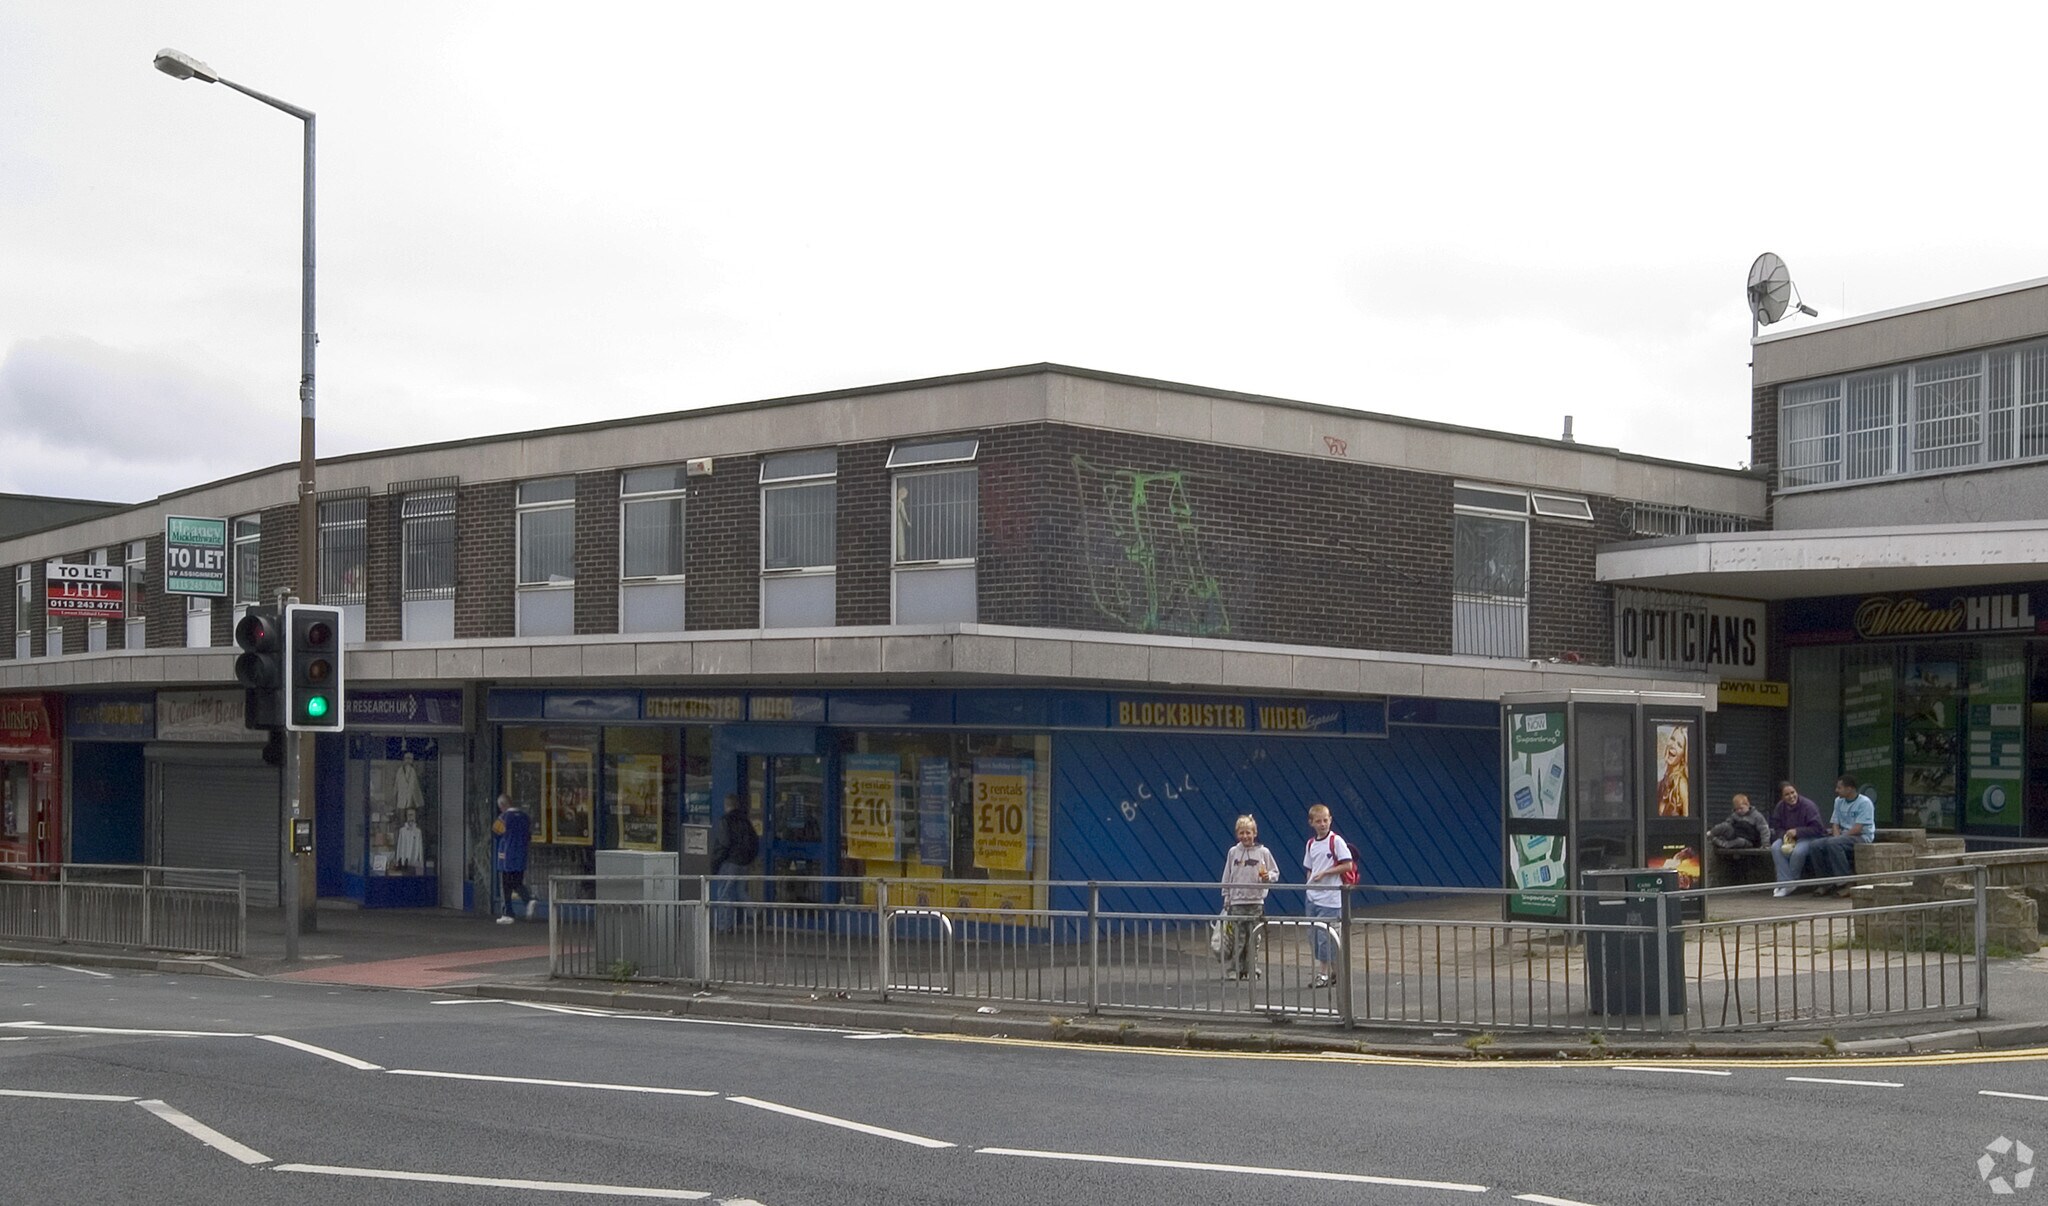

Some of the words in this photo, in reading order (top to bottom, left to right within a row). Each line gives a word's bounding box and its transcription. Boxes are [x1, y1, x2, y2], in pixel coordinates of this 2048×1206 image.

[169, 547, 191, 569] TO
[195, 549, 225, 570] LET
[58, 566, 79, 578] TO
[84, 568, 112, 579] LET
[168, 569, 179, 577] BY
[179, 571, 224, 579] ASSIGNMENT
[62, 581, 109, 599] LHL
[50, 600, 75, 609] 0113
[77, 601, 95, 609] 243
[97, 602, 120, 611] 4771
[1858, 598, 1966, 637] William
[1967, 593, 2035, 630] HILL
[1622, 607, 1756, 667] OPTICIANS
[1718, 681, 1755, 693] DWYN
[352, 700, 395, 714] RESEARCH
[396, 700, 409, 714] UK
[647, 697, 740, 719] BLOCKBUSTER
[750, 697, 793, 721] VIDEO
[1119, 701, 1246, 728] BLOCKBUSTER
[1259, 706, 1307, 729] VIDEO
[0, 703, 39, 736] Ainsleys
[1527, 719, 1545, 731] NOW
[1515, 734, 1557, 745] Superdrug
[850, 778, 859, 795] 3
[978, 782, 988, 801] 3
[990, 784, 1023, 796] rentals
[850, 797, 891, 827] £10
[978, 803, 1022, 835] £10
